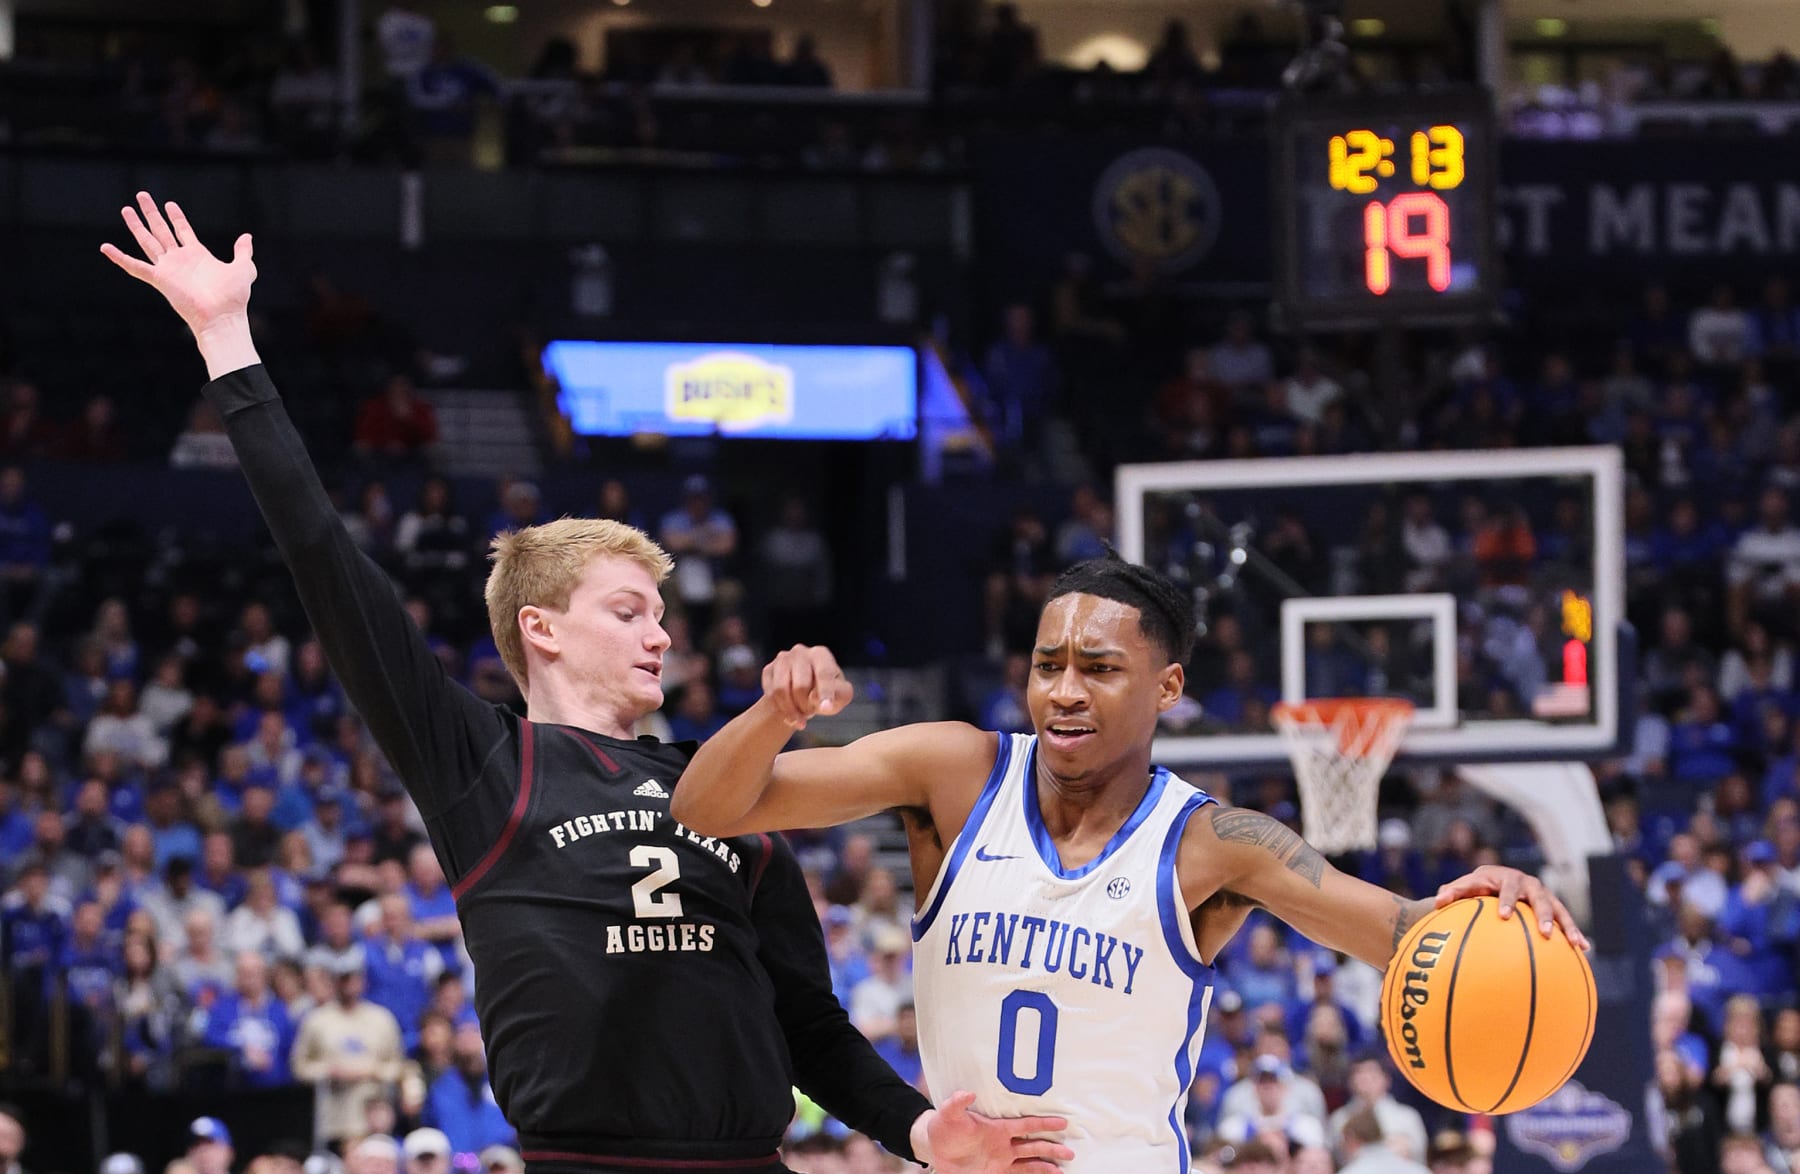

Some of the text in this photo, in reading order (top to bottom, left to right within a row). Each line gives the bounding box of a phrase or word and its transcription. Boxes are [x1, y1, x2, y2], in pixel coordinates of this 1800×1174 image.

[1328, 125, 1464, 194] 12:13
[1364, 192, 1451, 295] 19
[549, 810, 662, 848] FIGHTIN'
[633, 789, 669, 799] adidas
[629, 845, 684, 918] 2
[1107, 877, 1131, 899] SEC
[606, 924, 715, 953] AGGIES
[946, 911, 1143, 995] KENTUCKY
[1401, 931, 1451, 1069] Wilson
[997, 989, 1058, 1096] 0
